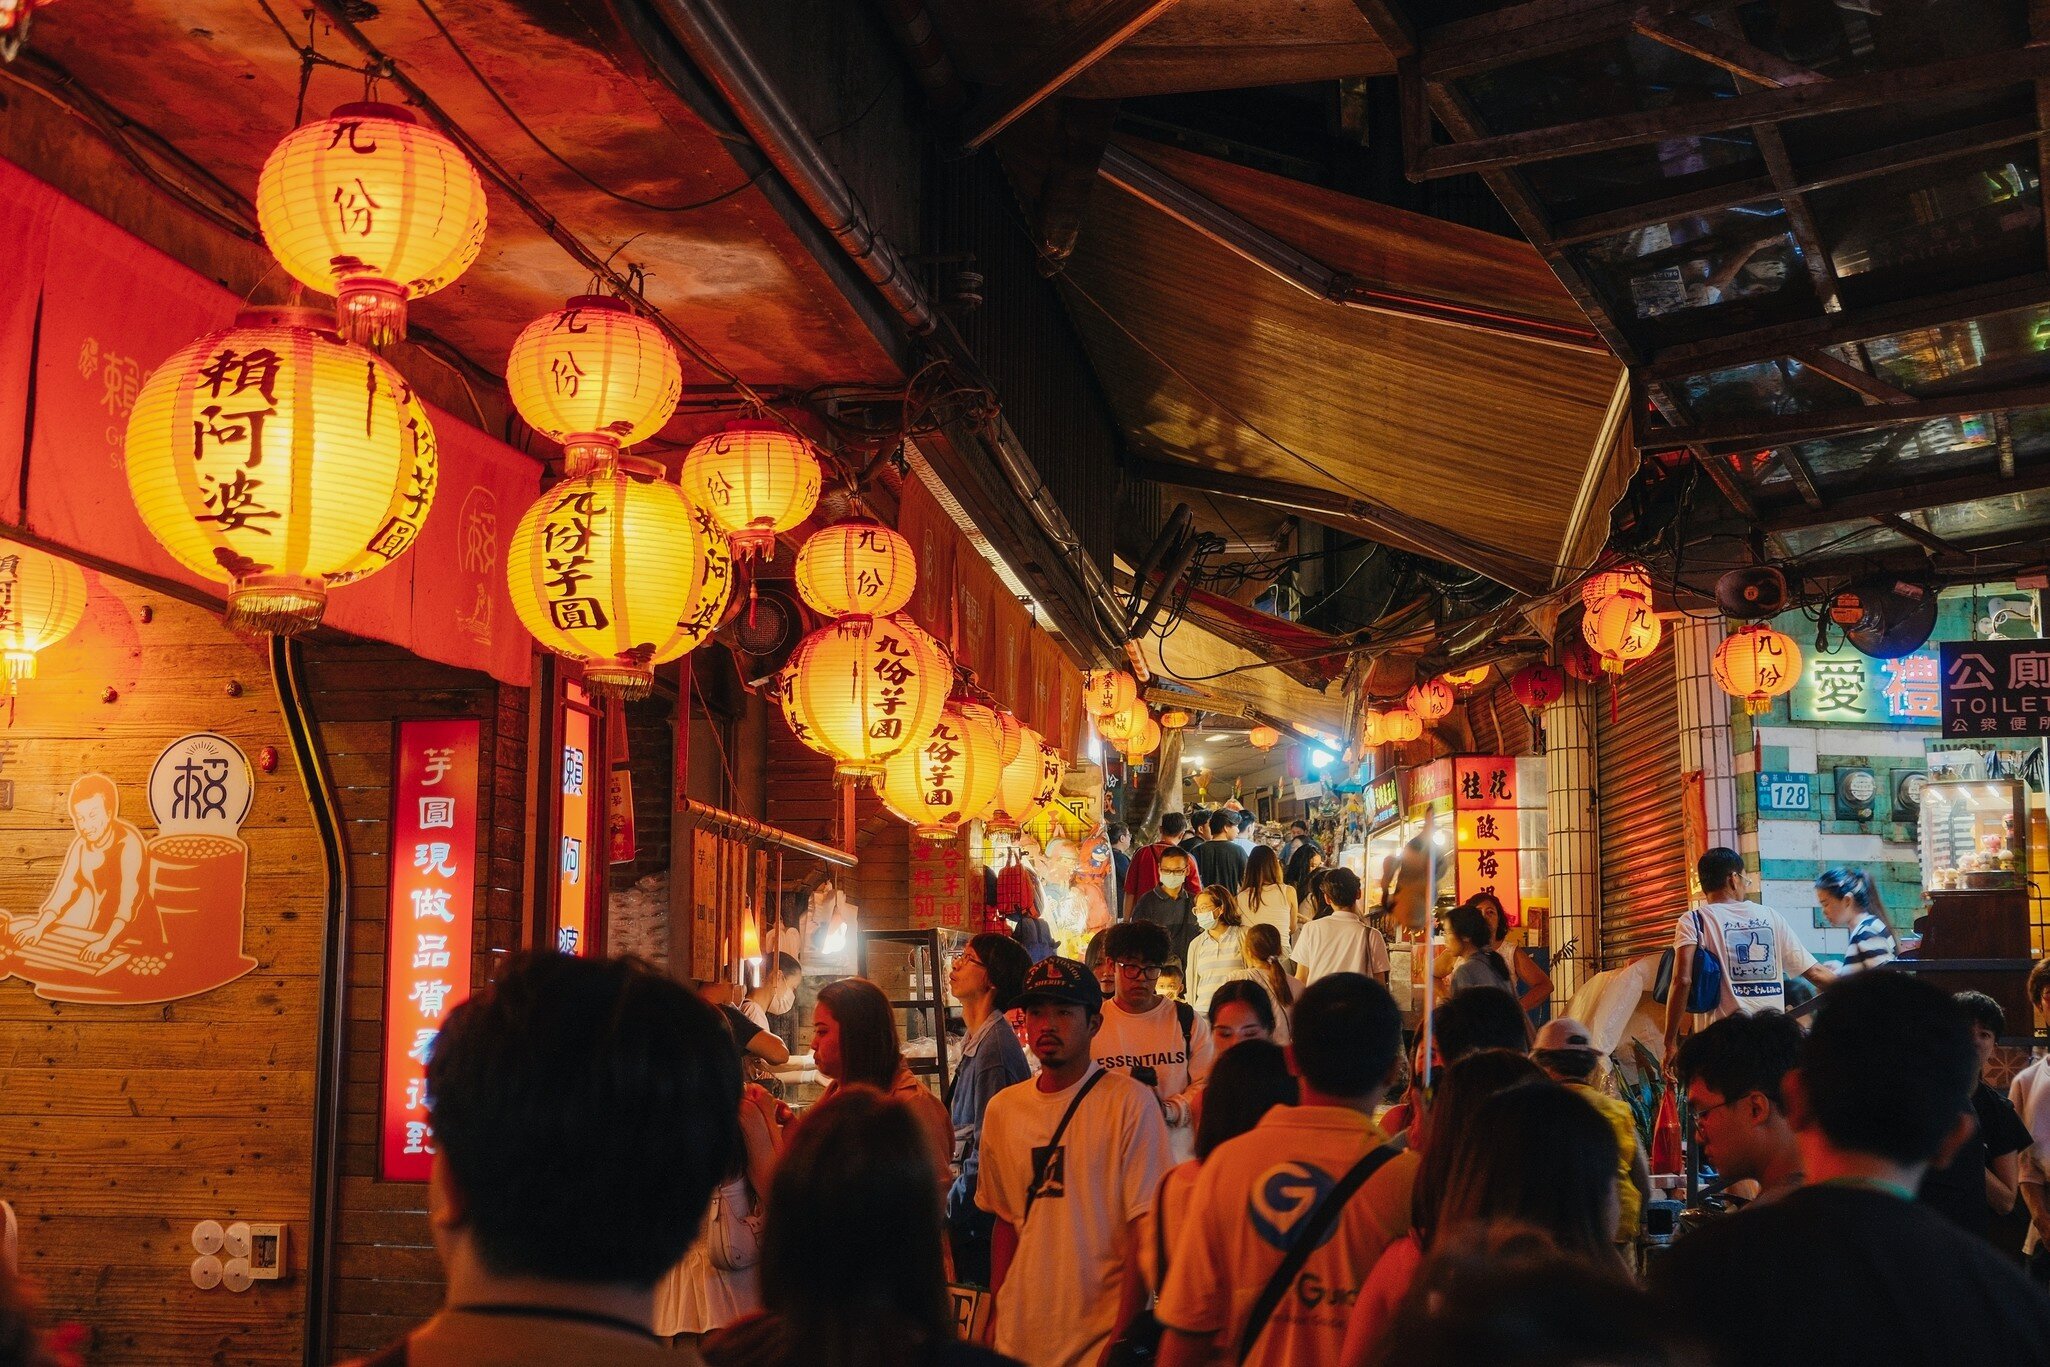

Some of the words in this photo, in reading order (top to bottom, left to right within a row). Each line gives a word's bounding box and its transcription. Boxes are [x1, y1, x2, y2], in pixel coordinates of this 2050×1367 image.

[326, 120, 380, 238] 九份
[551, 309, 588, 398] 九份
[194, 348, 282, 535] 賴阿婆
[704, 434, 734, 506] 九份
[540, 491, 609, 631] 九份芋圓
[857, 530, 886, 597] 九份
[870, 634, 916, 739] 九份芋圓
[1757, 635, 1783, 688] 九份
[924, 723, 962, 806] 九份芋圓
[1461, 769, 1512, 800] 桂花
[1774, 786, 1806, 806] 128
[1475, 813, 1500, 897] 酸梅
[1097, 1051, 1185, 1070] ESSENTIALS
